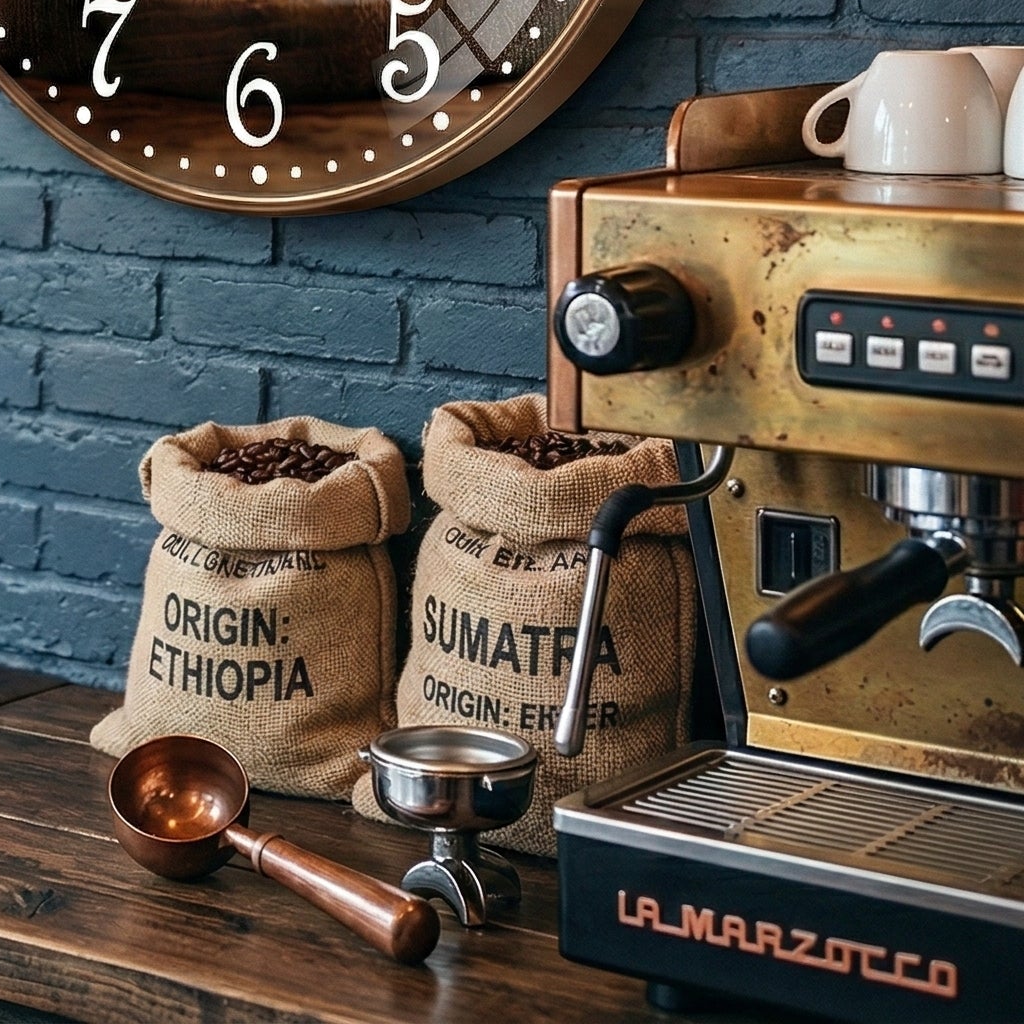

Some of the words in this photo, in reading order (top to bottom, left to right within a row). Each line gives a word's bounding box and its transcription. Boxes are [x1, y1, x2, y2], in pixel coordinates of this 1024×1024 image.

[225, 41, 284, 147] 6
[164, 592, 291, 647] ORIGIN:
[149, 635, 315, 702] ETHIOPIA
[423, 674, 510, 726] ORIGIN:
